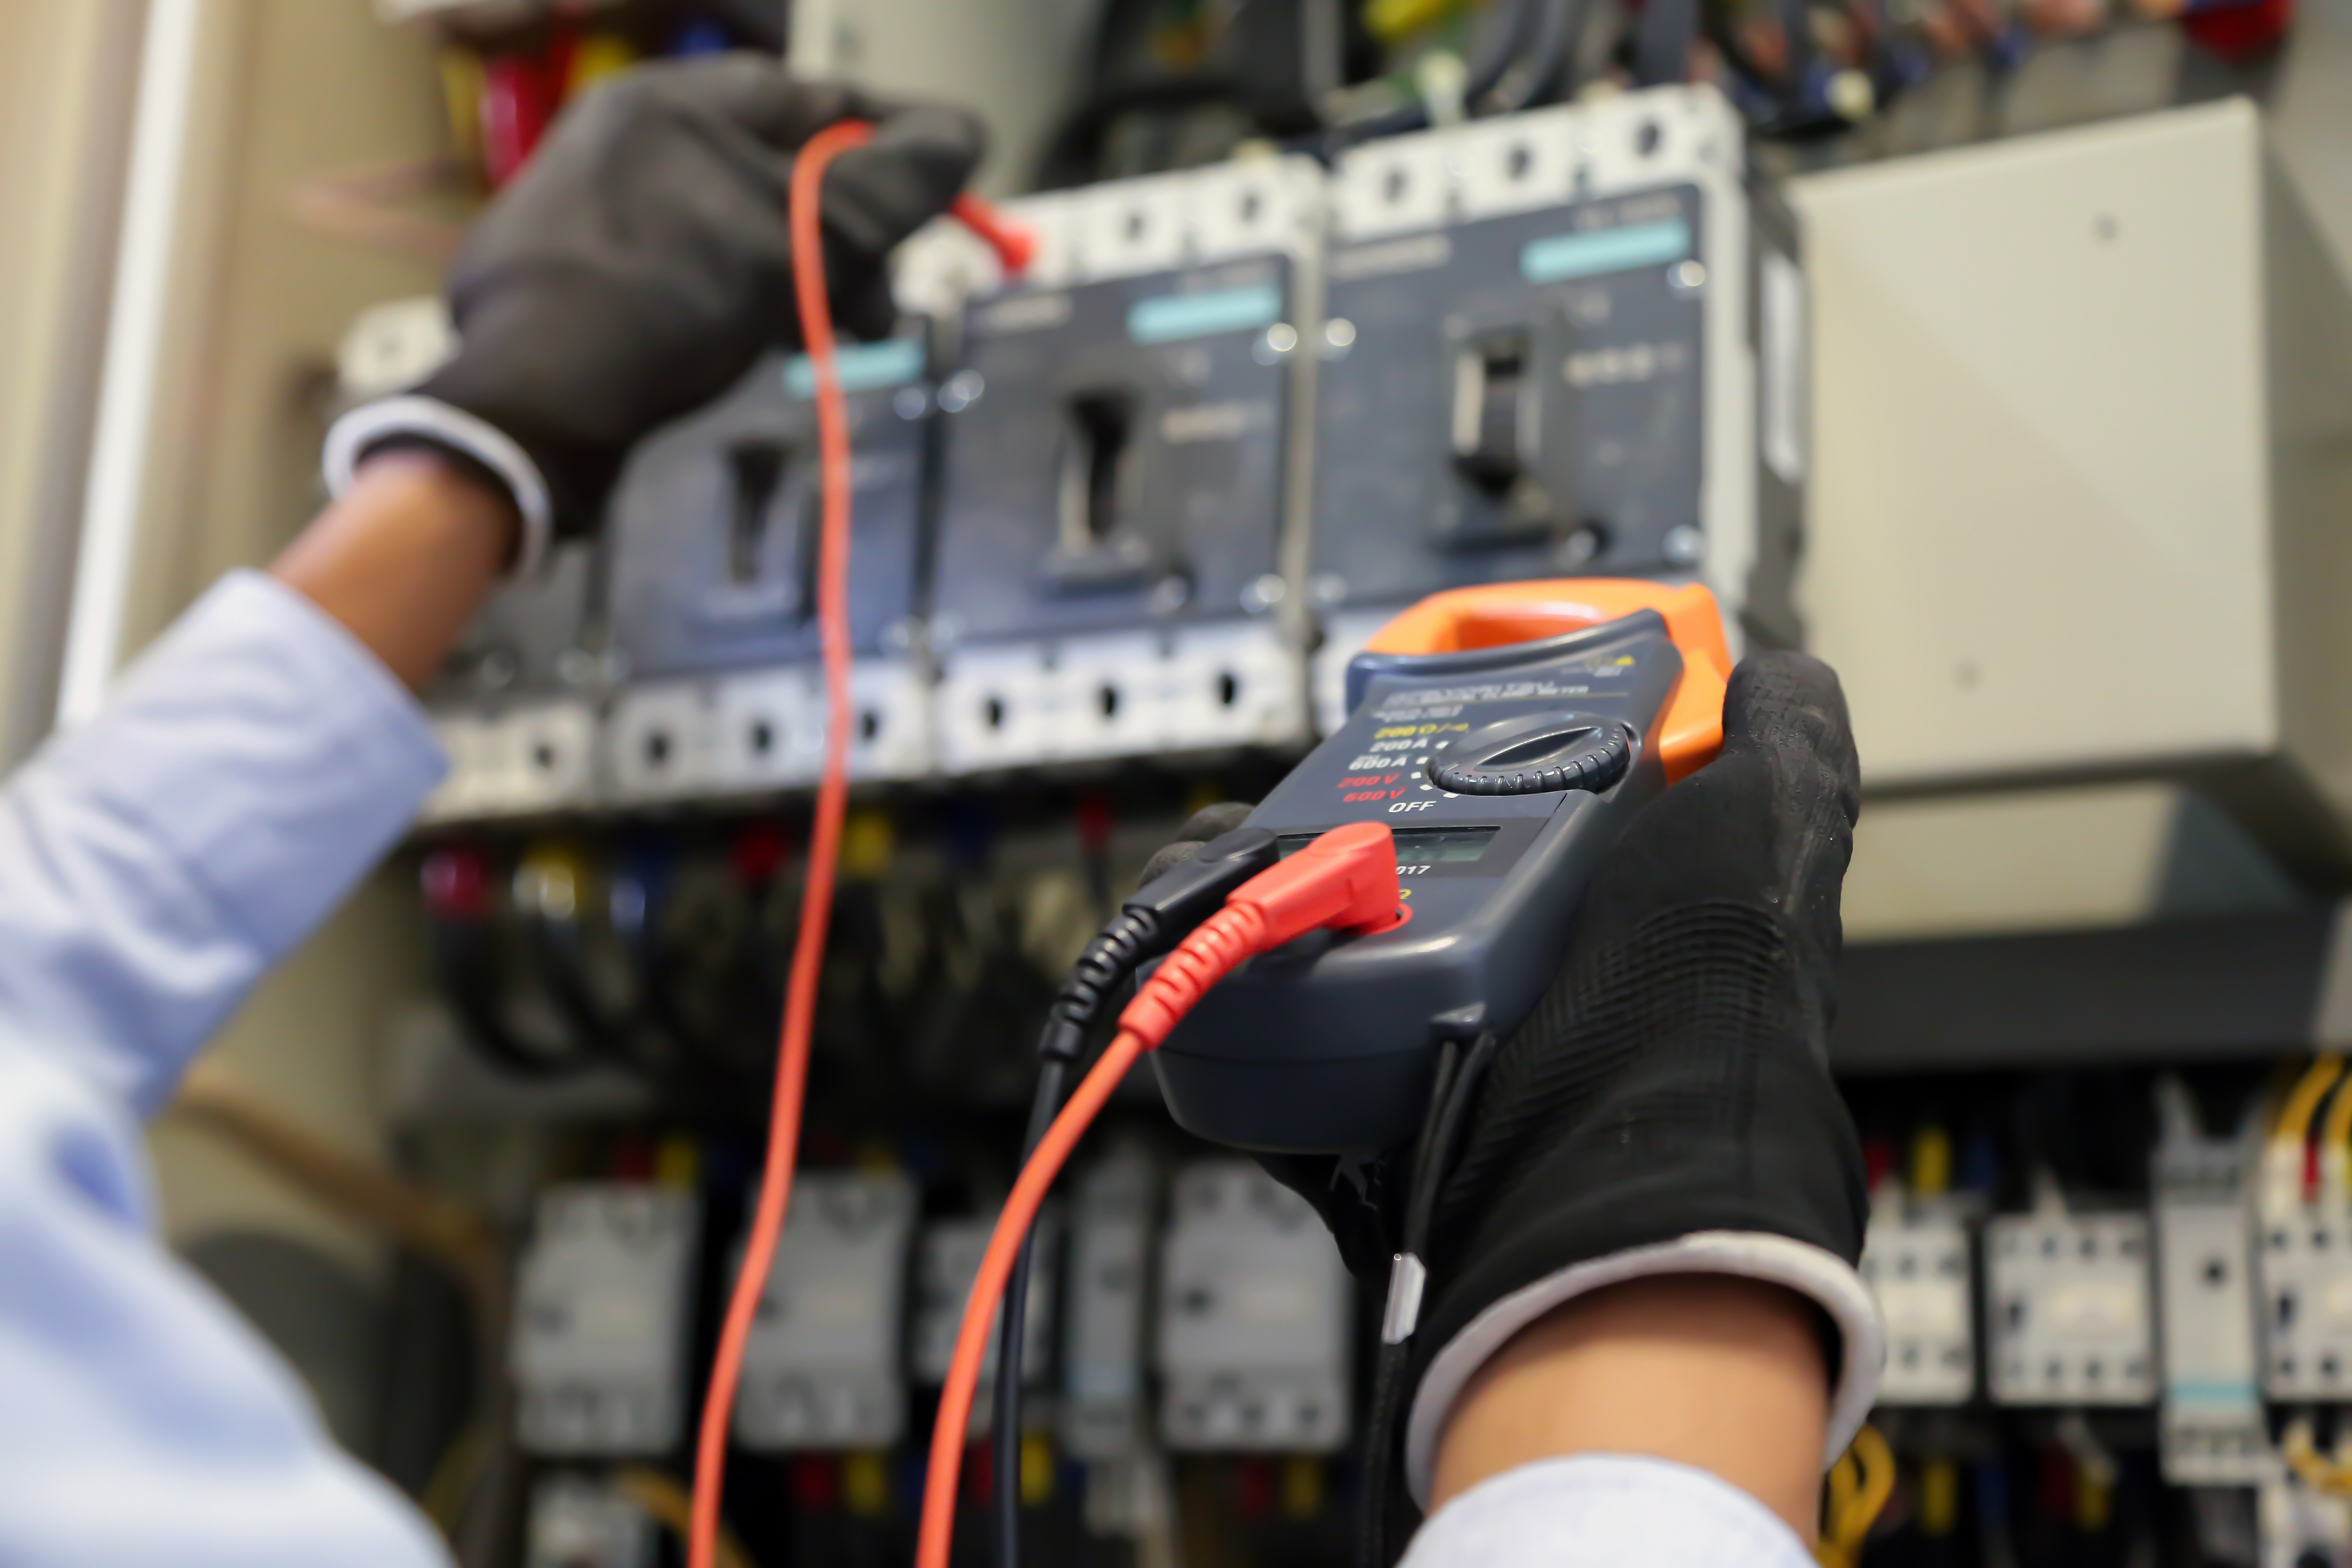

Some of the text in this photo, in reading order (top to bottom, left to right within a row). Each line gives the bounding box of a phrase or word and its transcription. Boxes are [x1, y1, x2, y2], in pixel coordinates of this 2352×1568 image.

[1370, 737, 1428, 753] 200 A
[1349, 757, 1392, 771] 600
[1390, 756, 1408, 768] A
[1337, 773, 1401, 788] 200 V
[1343, 788, 1407, 802] 600 V
[1389, 801, 1437, 813] OFF
